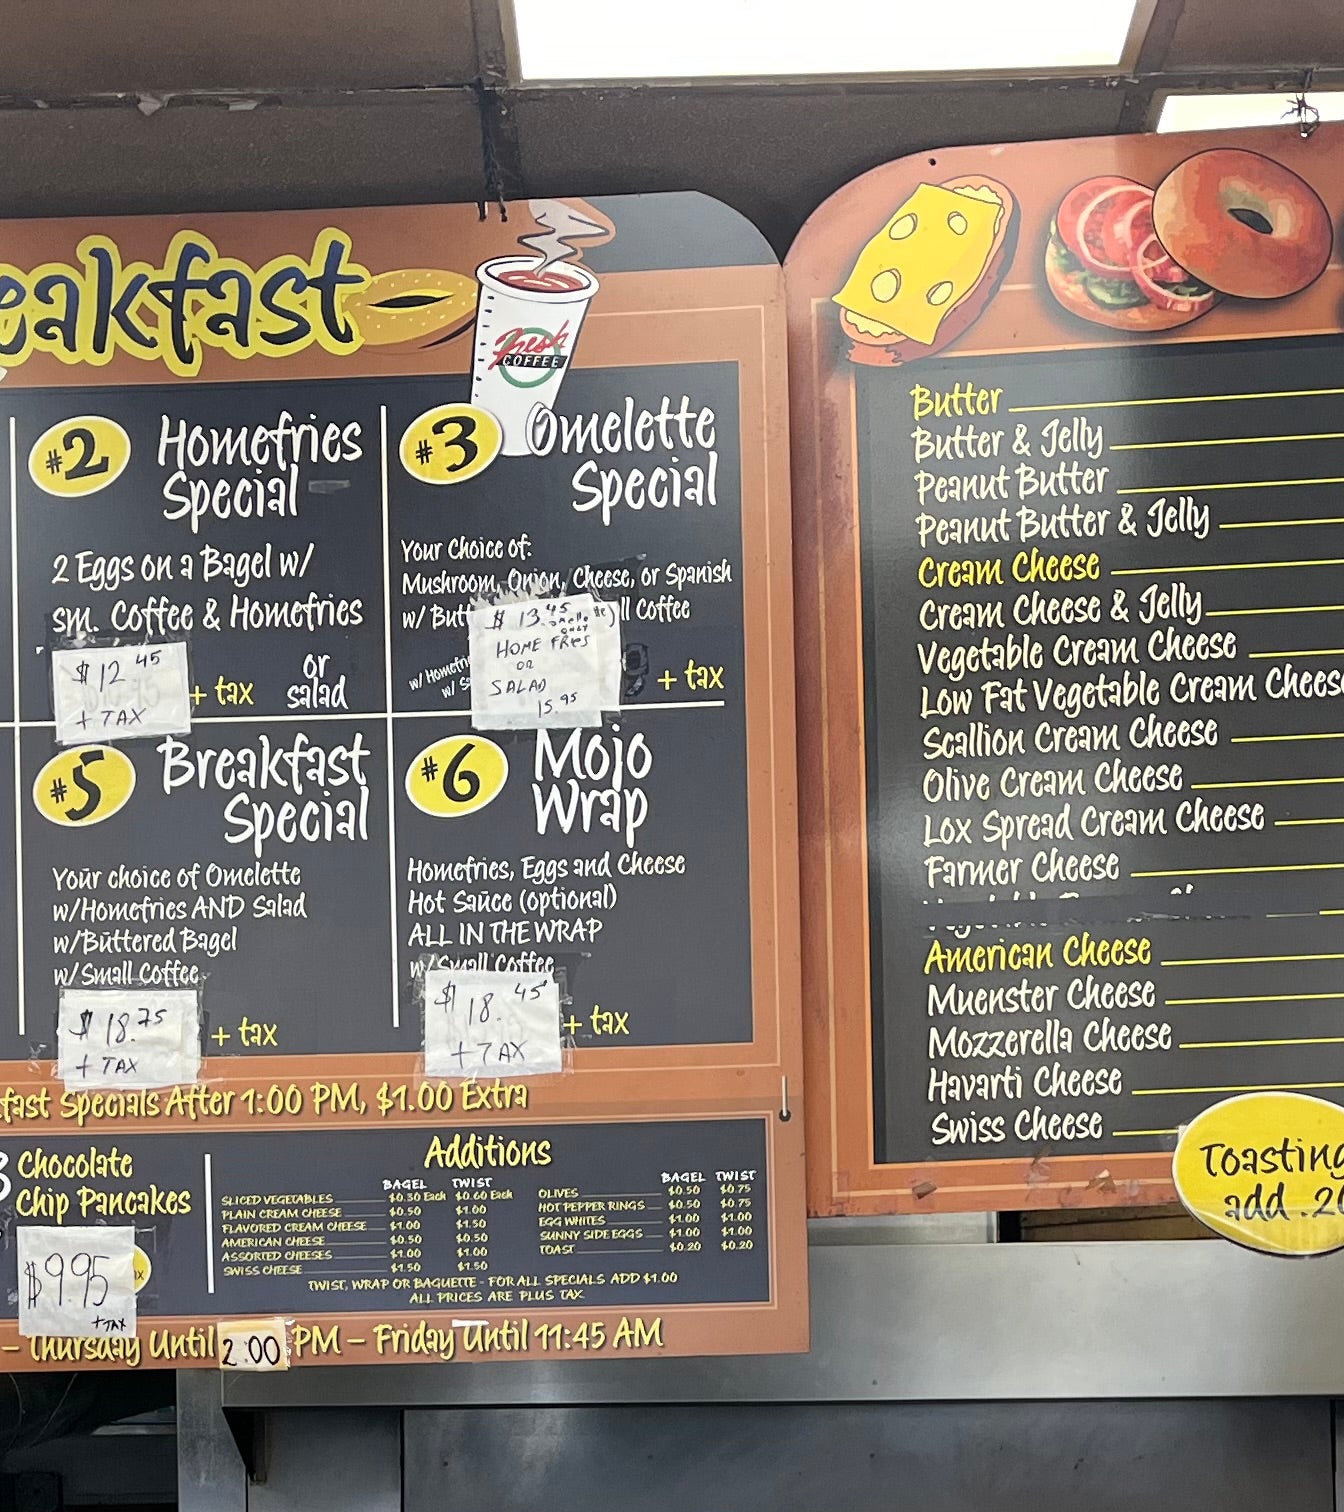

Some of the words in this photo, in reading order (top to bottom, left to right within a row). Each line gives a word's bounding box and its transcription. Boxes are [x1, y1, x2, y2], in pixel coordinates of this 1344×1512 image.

[488, 320, 569, 370] Fresh
[502, 355, 560, 368] COFFEE
[910, 382, 1004, 421] Butter
[45, 427, 110, 481] #2
[157, 411, 362, 468] Homefries
[415, 416, 478, 472] #3
[527, 396, 716, 455] Omelette
[163, 463, 298, 531] Special
[571, 449, 717, 524] Special
[917, 552, 1005, 589] Cream
[1012, 547, 1101, 584] Cheese
[50, 750, 105, 821] #5
[156, 734, 370, 796] Breakfast
[421, 743, 481, 802] #6
[534, 727, 652, 791] Mojo
[225, 796, 370, 857] Special
[532, 777, 648, 847] Wrap
[408, 921, 452, 947] ALL
[459, 921, 484, 945] IN
[491, 920, 530, 945] THE
[534, 918, 603, 944] WRAP
[927, 1020, 1073, 1060] Mozzerella
[1083, 1016, 1173, 1054] Cheese
[60, 1087, 160, 1126] Specials
[166, 1087, 235, 1120] After
[241, 1081, 303, 1113] 1:00
[312, 1081, 366, 1115] PM,
[377, 1081, 453, 1115] $1.00
[460, 1083, 529, 1111] Extra
[17, 1148, 133, 1180] Chocolate
[423, 1132, 553, 1169] Additions
[382, 1178, 427, 1191] BAGEL
[451, 1177, 493, 1188] TWIST
[538, 1187, 579, 1199] OLIVES
[668, 1185, 701, 1196] $0.50
[720, 1184, 752, 1195] $0.75
[1224, 1184, 1290, 1224] add
[16, 1189, 70, 1224] Chip
[77, 1188, 192, 1216] Pancakes
[409, 1292, 434, 1304] ALL
[437, 1291, 483, 1304] PRICES
[488, 1291, 513, 1302] ARE
[519, 1290, 555, 1301] PLUS
[560, 1288, 585, 1301] TAX
[29, 1336, 142, 1368] Thursday
[148, 1324, 215, 1358] Until
[291, 1326, 342, 1357] PM
[373, 1323, 457, 1362] Friday
[462, 1323, 529, 1354] Until
[534, 1320, 607, 1352] 11:45
[612, 1317, 664, 1350] AM
